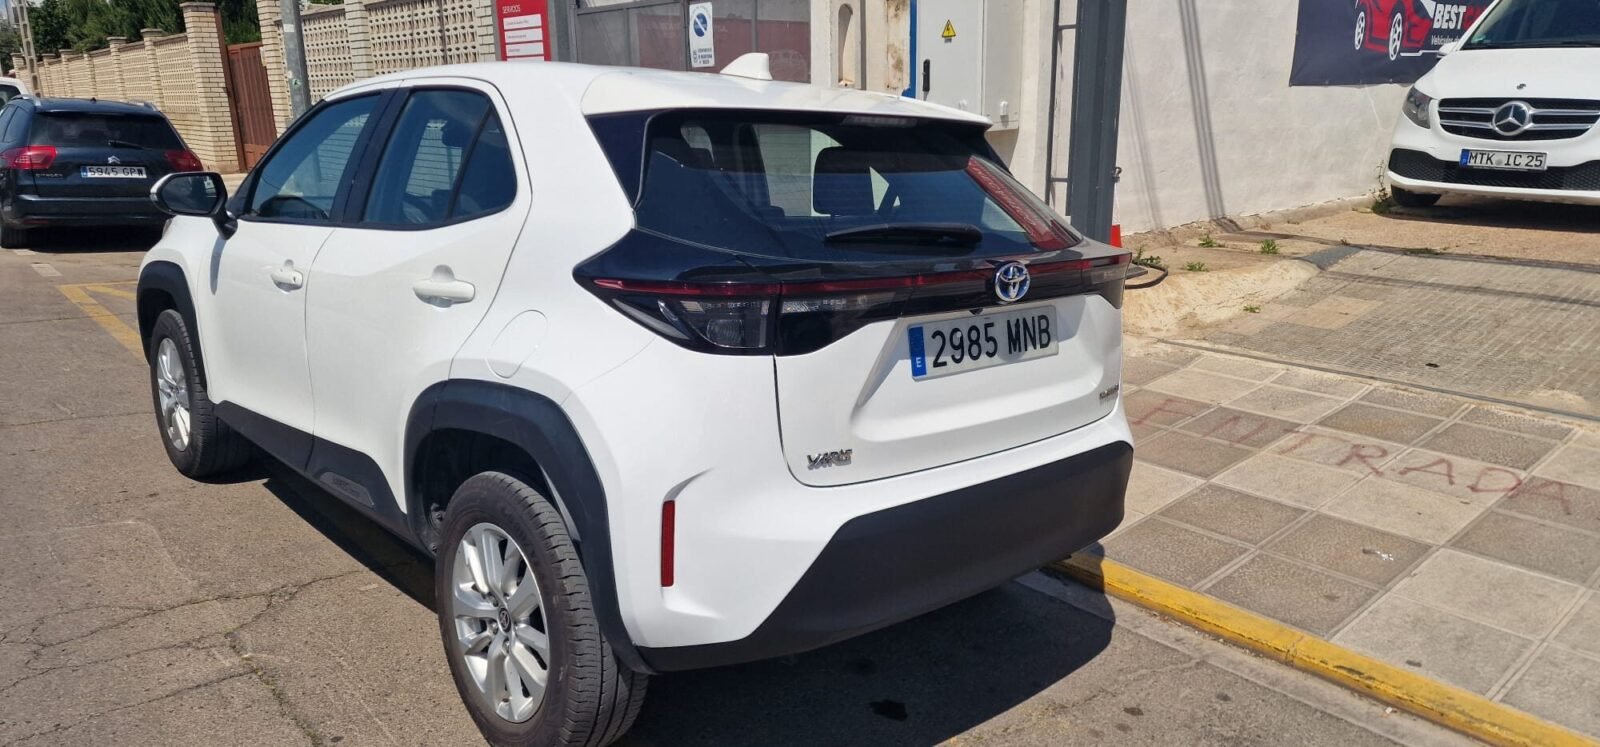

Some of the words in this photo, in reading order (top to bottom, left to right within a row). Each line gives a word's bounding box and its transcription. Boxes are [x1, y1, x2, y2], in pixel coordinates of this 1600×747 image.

[1468, 152, 1495, 165] MTK
[1504, 154, 1522, 166] IC
[1524, 155, 1544, 167] 25
[931, 322, 998, 368] 2985
[1006, 314, 1052, 355] MNB
